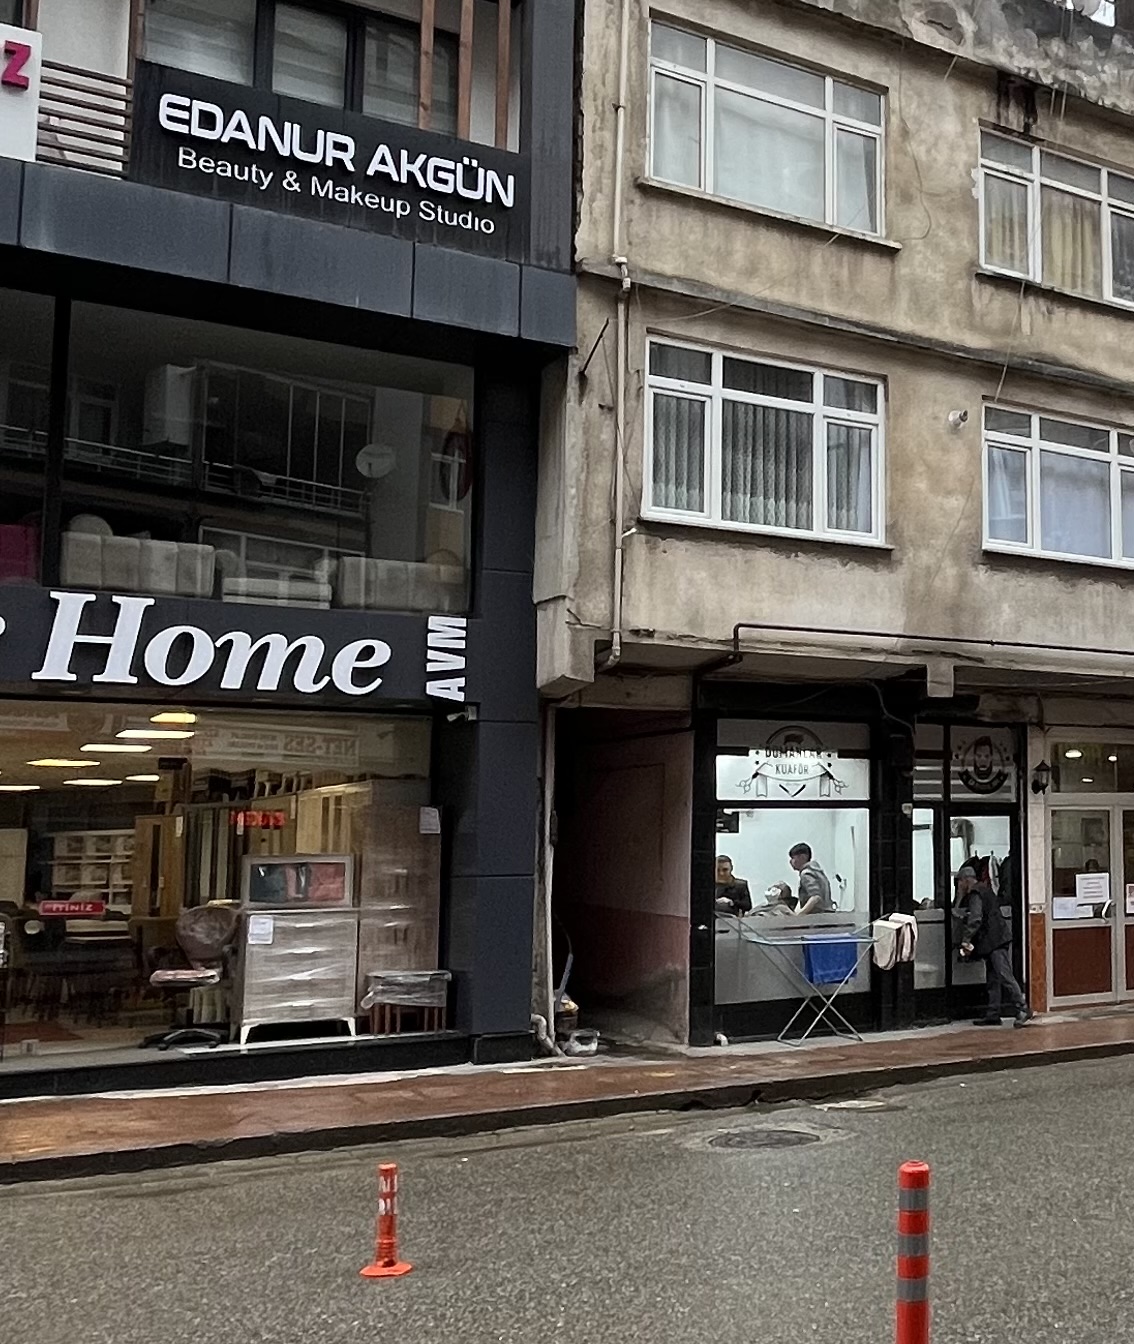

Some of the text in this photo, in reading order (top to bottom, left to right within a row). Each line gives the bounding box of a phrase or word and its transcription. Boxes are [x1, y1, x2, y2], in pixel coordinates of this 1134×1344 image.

[1, 40, 32, 90] Z
[159, 93, 515, 208] EDANUR AKGÜN
[178, 146, 274, 190] Beauty
[282, 170, 301, 193] &
[311, 175, 411, 218] Makeup
[31, 591, 467, 702] Home AVM
[775, 763, 809, 775] KUAFÖR
